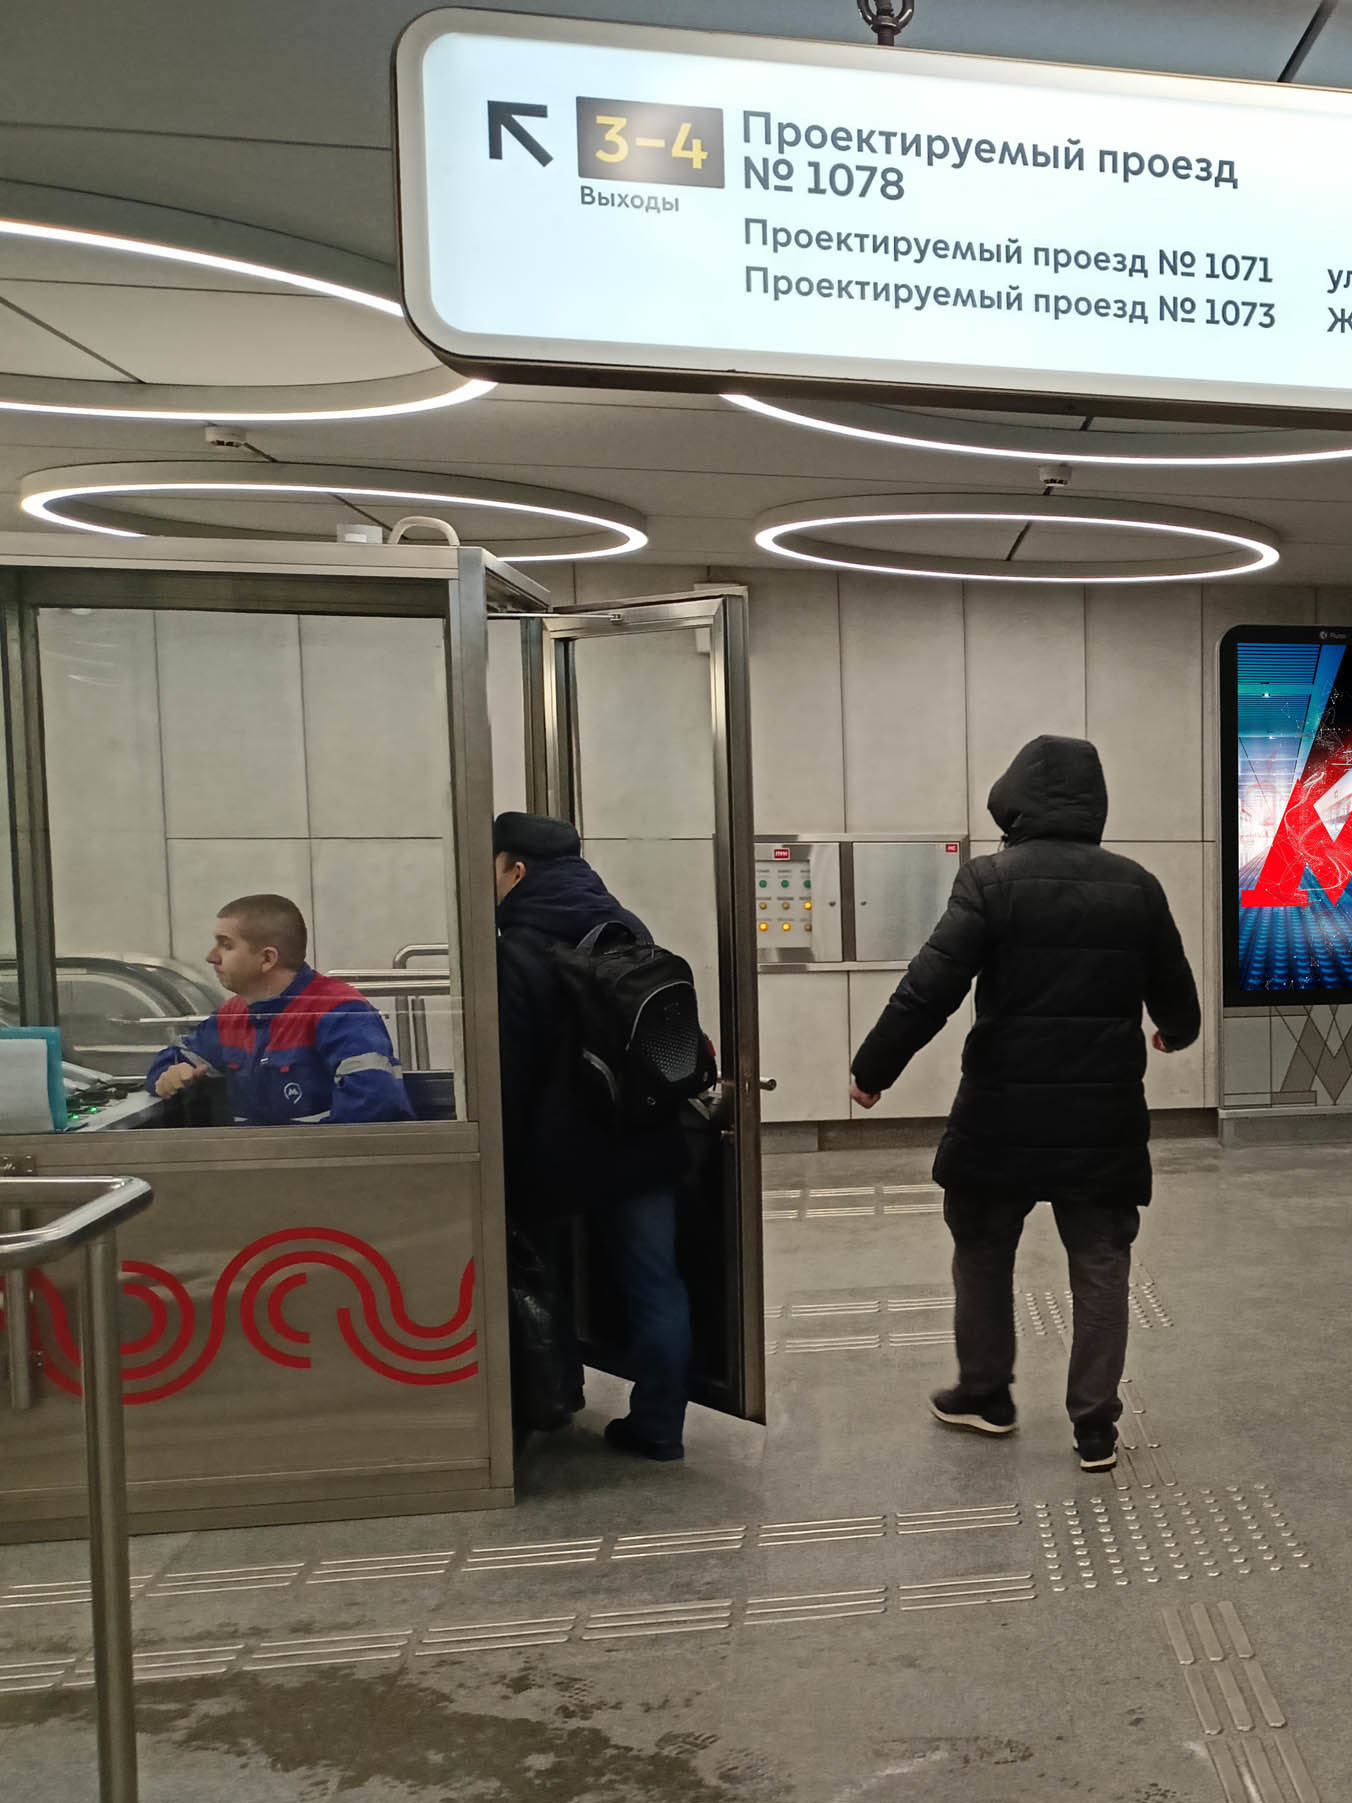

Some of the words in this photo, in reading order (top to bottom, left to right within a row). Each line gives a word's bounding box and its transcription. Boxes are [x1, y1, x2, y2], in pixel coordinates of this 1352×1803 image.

[742, 109, 1085, 173] Проектируемый
[1098, 149, 1239, 190] проезд
[743, 155, 795, 193] №
[807, 160, 905, 201] 1078
[579, 184, 680, 214] Выходы
[744, 217, 1023, 265] Проектируемый
[1033, 246, 1149, 279] проезд
[1158, 248, 1197, 278] №
[1205, 252, 1274, 284] 1071
[744, 265, 1023, 312] Проектируемый
[1033, 293, 1149, 325] проезд
[1158, 294, 1197, 324] №
[1205, 297, 1277, 329] 1073
